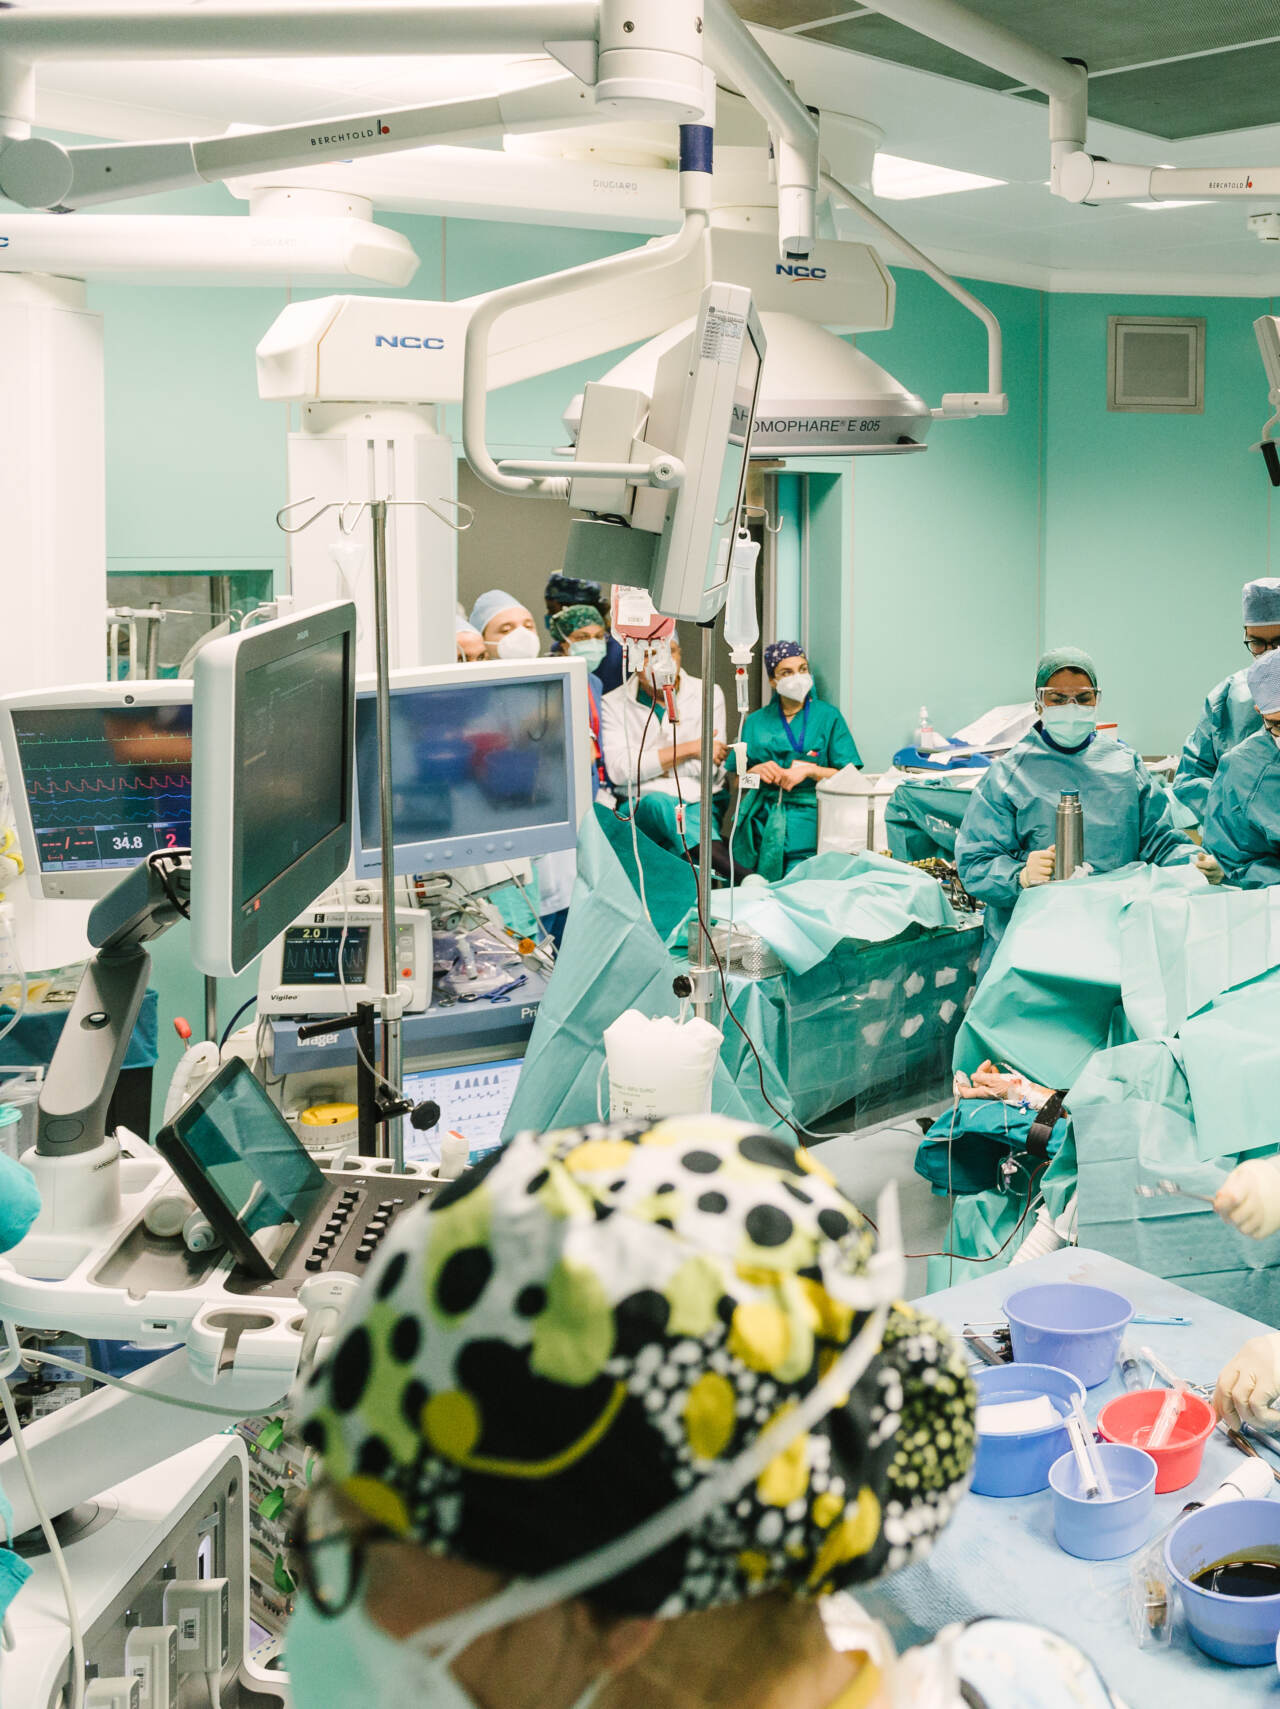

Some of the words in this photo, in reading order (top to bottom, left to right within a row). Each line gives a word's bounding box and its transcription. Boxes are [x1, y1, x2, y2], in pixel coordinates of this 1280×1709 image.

[310, 129, 374, 146] BERCHTOLD
[775, 263, 828, 279] NCC
[375, 335, 445, 350] NCC
[847, 419, 857, 432] E
[859, 420, 881, 432] 805
[112, 835, 144, 850] 34.8
[302, 928, 321, 939] 2.0
[271, 994, 298, 1002] Vigileo
